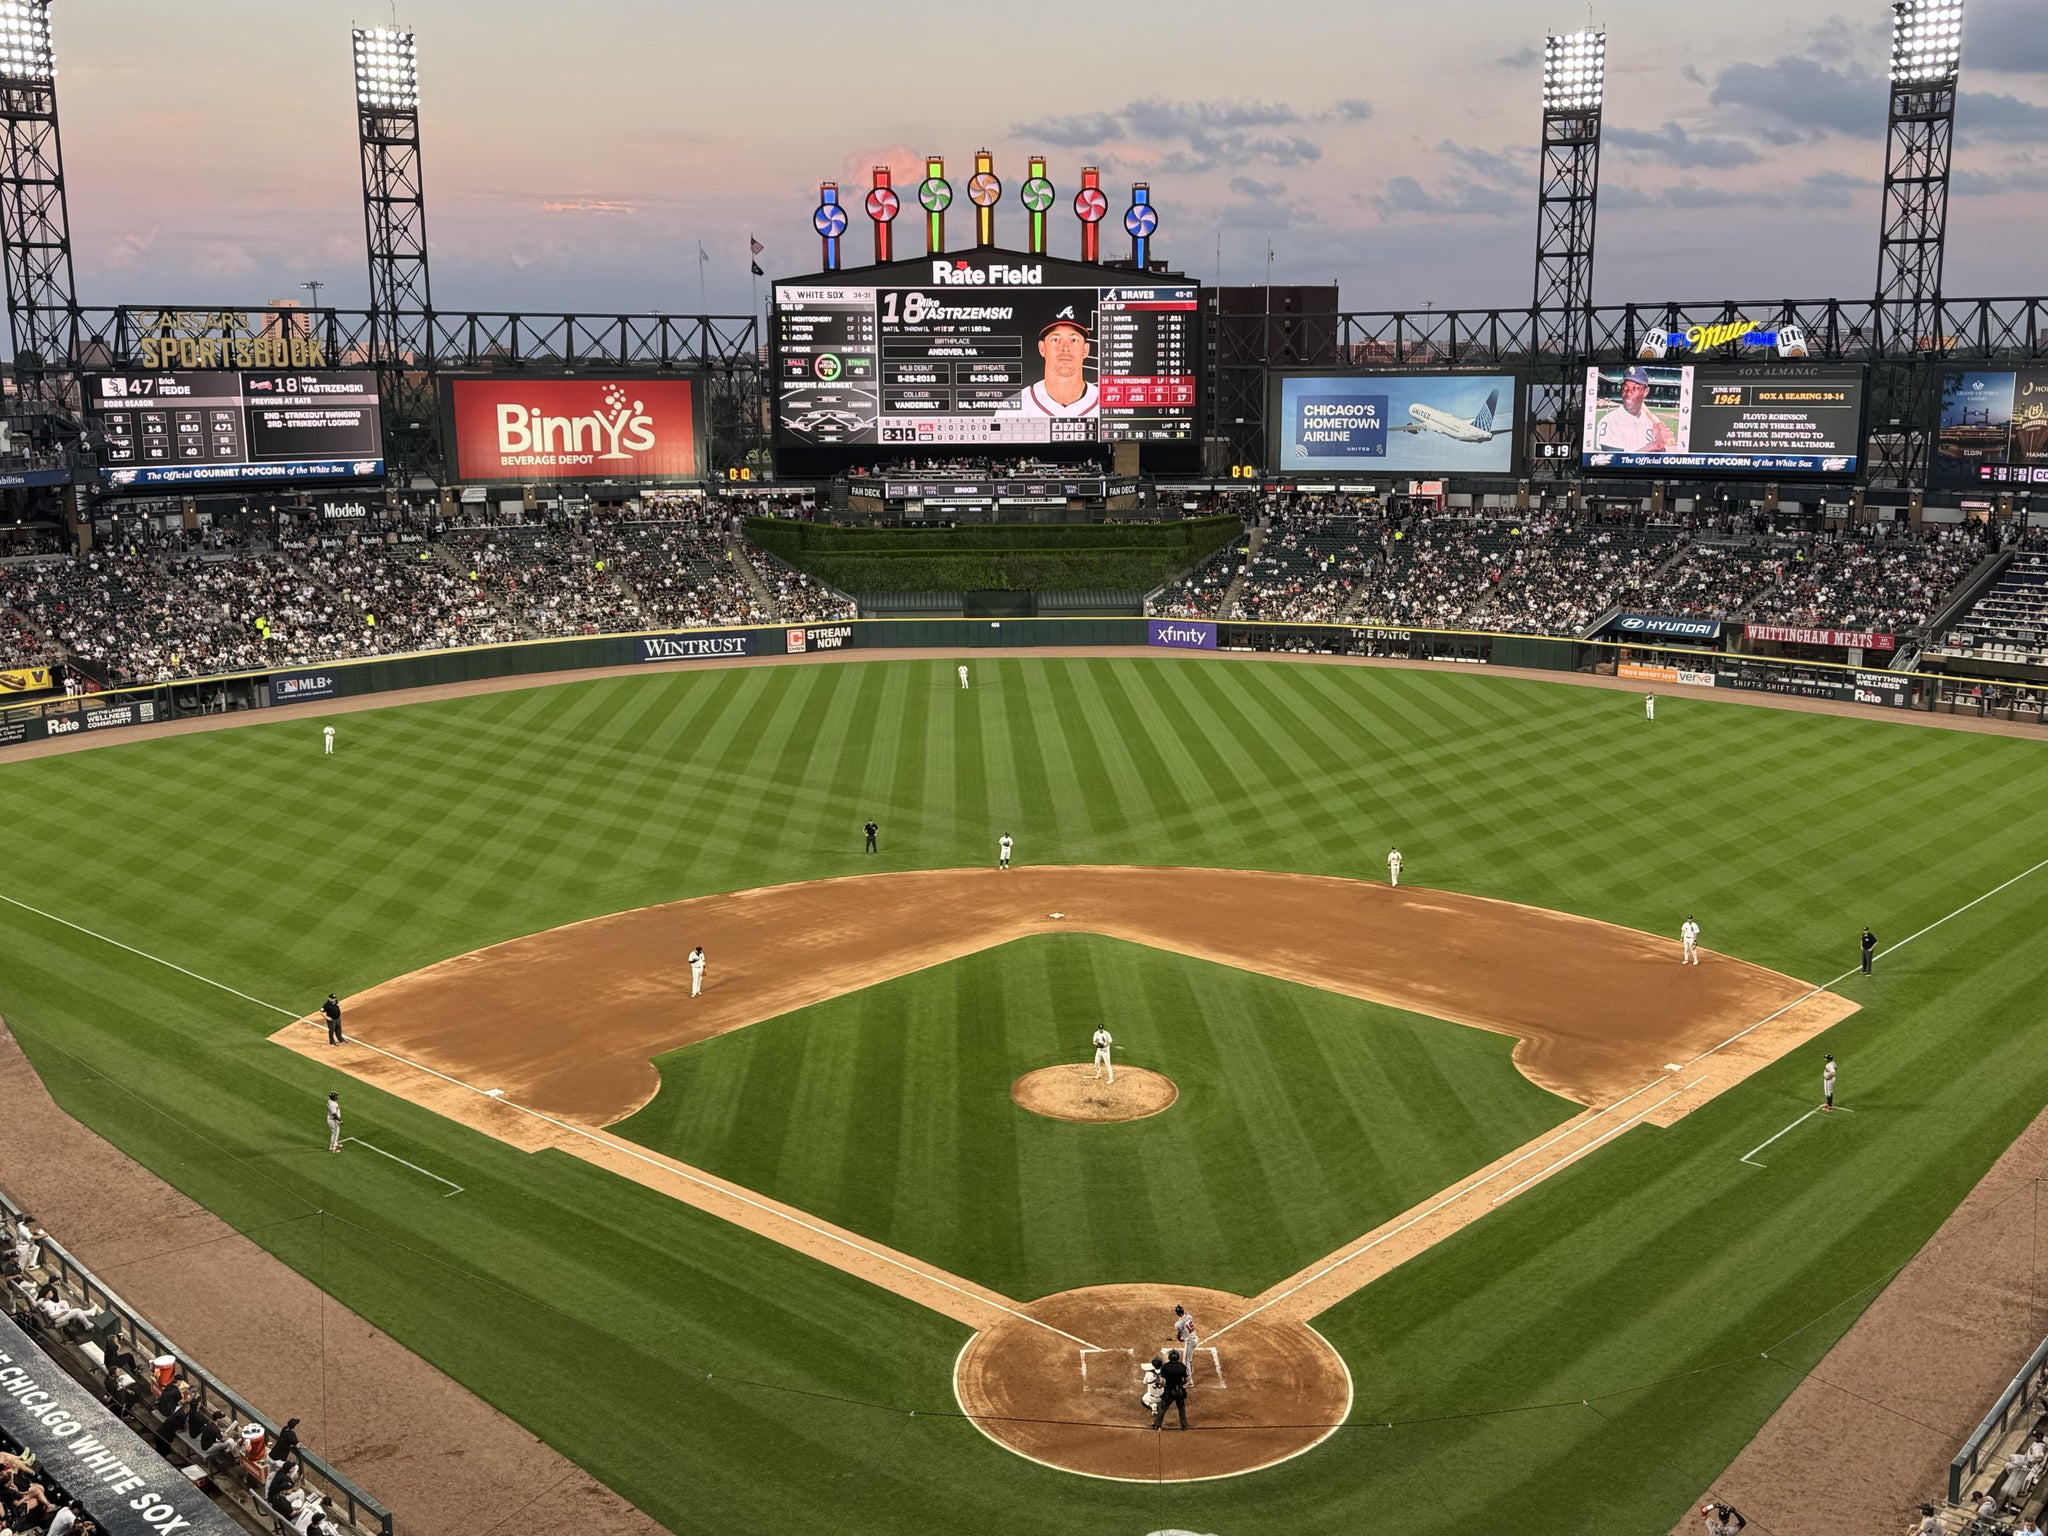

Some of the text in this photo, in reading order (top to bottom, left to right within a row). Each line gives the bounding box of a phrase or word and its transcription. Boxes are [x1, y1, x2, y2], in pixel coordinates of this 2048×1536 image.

[933, 261, 1042, 284] Rate Field
[1121, 290, 1155, 299] BRAVES
[882, 292, 925, 323] 18
[917, 298, 940, 308] Mike
[920, 307, 1013, 320] YASTRZEMSKI
[138, 311, 249, 331] CAESARS
[1645, 332, 1666, 347] Lite
[1686, 320, 1761, 353] Miller
[1780, 330, 1803, 347] Lite
[141, 337, 327, 368] SPORTSBOOK
[928, 348, 964, 356] ANDOVER,
[1738, 368, 1818, 376] SOX ALMANAC
[158, 377, 176, 385] Erick
[275, 378, 298, 392] 18
[301, 376, 317, 384] Mike
[129, 379, 153, 394] 47
[159, 386, 191, 395] FEDDE
[301, 384, 364, 393] YASTRZEMSKI
[1713, 394, 1741, 405] 1964
[1823, 393, 1845, 401] 30-14
[124, 399, 154, 408] SEASON
[895, 401, 940, 409] VANDERBILT
[972, 401, 988, 409] 14TH
[263, 412, 280, 420] 2ND
[284, 411, 324, 420] STRIKEOUT
[1303, 404, 1376, 416] CHICAGO'S
[1411, 409, 1431, 420] UNITED
[1742, 413, 1807, 421] FLOYD ROBINSON
[215, 423, 232, 431] 4.71
[267, 420, 282, 428] 3RD
[327, 419, 359, 427] LOOKING
[497, 400, 656, 459] Binny's
[1304, 418, 1380, 430] HOMETOWN
[1770, 422, 1795, 430] THREE
[883, 429, 903, 439] 2-1
[907, 429, 914, 439] 1
[1303, 431, 1350, 442] AIRLINE
[220, 447, 231, 455] 24
[1544, 445, 1569, 457] 8:19
[1791, 441, 1835, 449] BALTIMORE
[501, 454, 594, 466] BEVERAGE DEPOT
[1635, 457, 1662, 465] Official
[1662, 457, 1705, 465] GOURMET
[1707, 458, 1750, 467] POPCORN
[1752, 458, 1761, 467] of
[1761, 458, 1773, 467] the
[1775, 459, 1797, 467] White
[1798, 460, 1813, 468] Sox
[147, 472, 161, 480] The
[163, 470, 193, 480] Official
[193, 468, 239, 478] GOURMET
[241, 467, 286, 476] POPCORN
[287, 466, 296, 475] of
[296, 466, 308, 474] the
[309, 465, 330, 474] White
[331, 465, 345, 473] Sox
[729, 468, 750, 480] 0:10
[1232, 466, 1252, 478] 0:10
[851, 487, 880, 498] FAN DECK
[1109, 485, 1136, 496] FAN DECK
[323, 502, 366, 518] Modelo
[401, 534, 422, 542] Modelo
[807, 627, 851, 639] STREAM
[1646, 620, 1711, 634] HYUNDAI
[1157, 625, 1207, 645] xfinity
[1351, 628, 1411, 640] THE PATIO
[1747, 625, 1828, 644] WHITTINGHAM
[1834, 632, 1873, 648] MEATS
[643, 637, 746, 657] WINTRUST
[817, 637, 842, 649] NOW
[1638, 670, 1661, 678] MONEY
[1680, 672, 1711, 684] verve
[1856, 673, 1908, 685] EVERYTHING
[299, 677, 333, 690] MLB+
[1855, 680, 1900, 690] WELLNESS
[1855, 689, 1881, 703] Rate
[87, 711, 131, 723] WELLNESS
[87, 717, 131, 728] COMMUNITY
[47, 718, 79, 734] Rate
[0, 1366, 191, 1536] CHICAGO WHITE SOX
